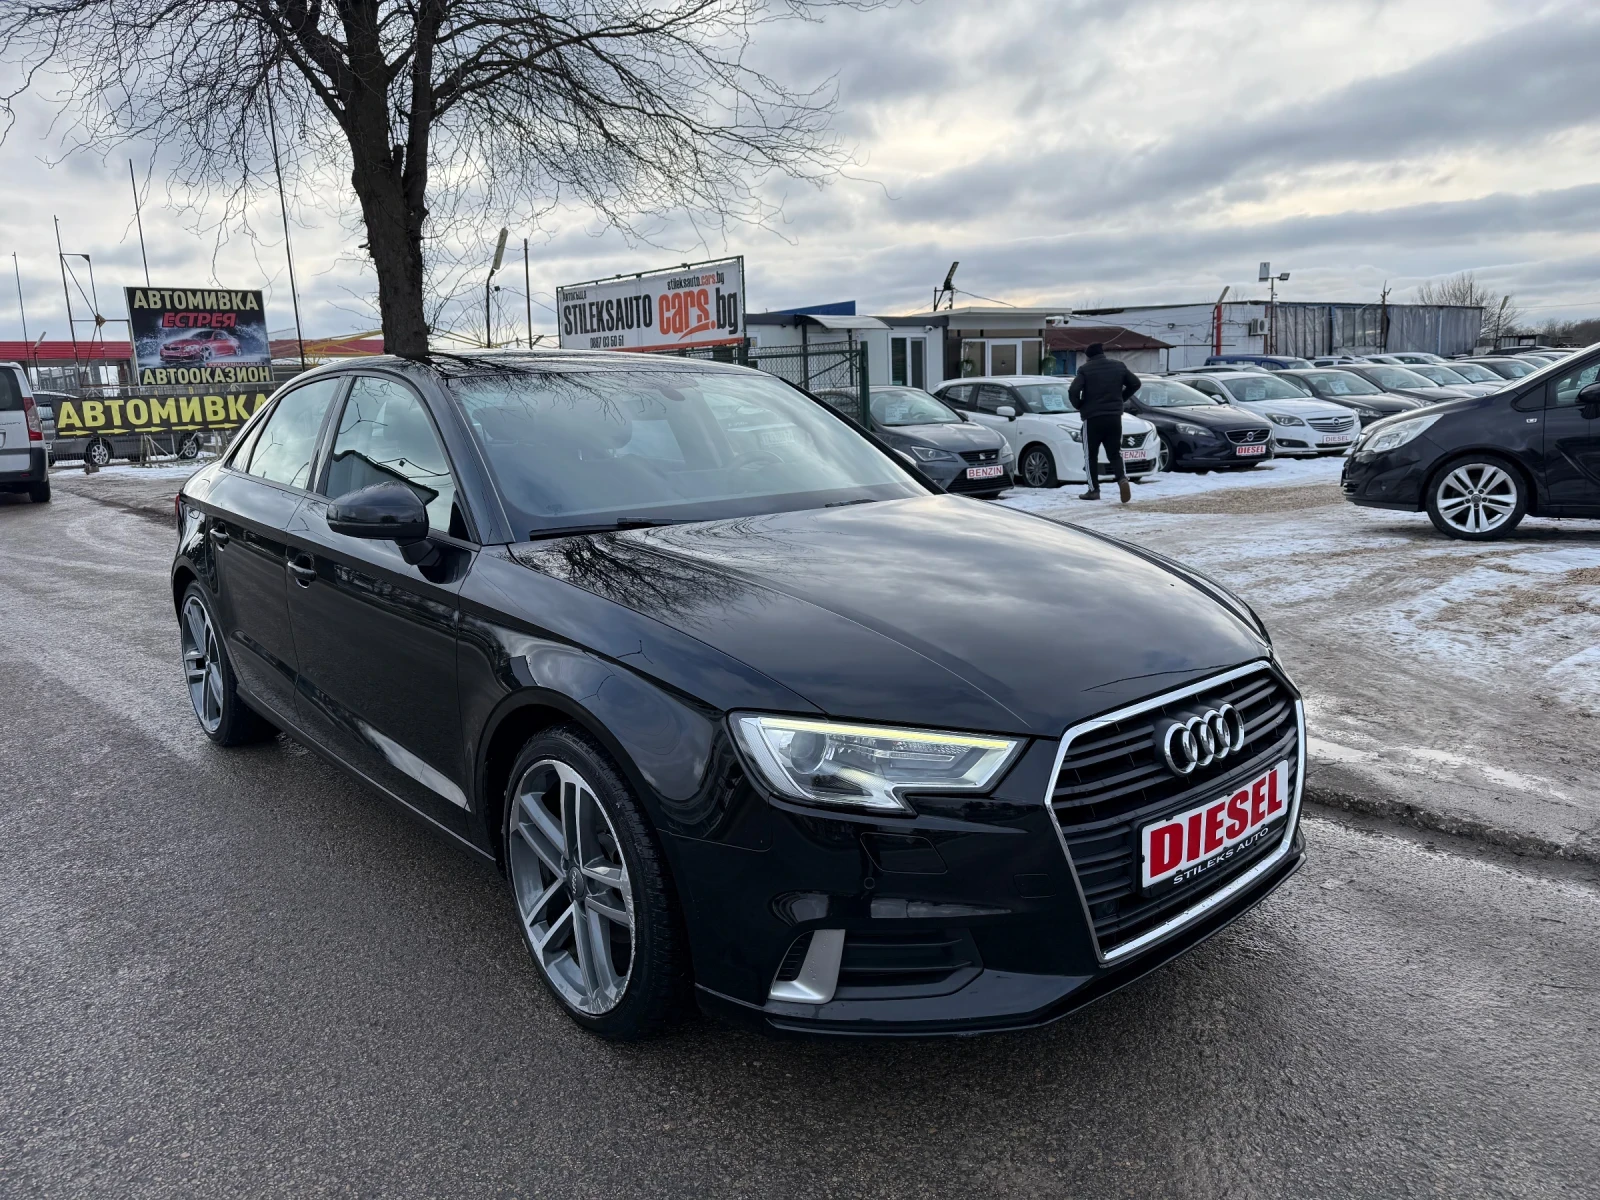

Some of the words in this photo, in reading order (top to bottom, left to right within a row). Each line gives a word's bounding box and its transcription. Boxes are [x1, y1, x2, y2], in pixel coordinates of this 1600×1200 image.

[668, 271, 724, 290] stileksauto.cars.bg
[133, 289, 259, 310] АВТОМИВКА
[162, 312, 237, 328] ЕСТРЕЯ
[563, 294, 653, 336] STILEKSAUTO
[143, 366, 270, 385] АВТООКАЗИОН
[1237, 445, 1265, 454] DIESEL
[968, 466, 1002, 478] BENZIN
[1149, 768, 1283, 879] DIESEL
[1173, 848, 1234, 885] STILEKS
[1237, 827, 1269, 852] AUTO
